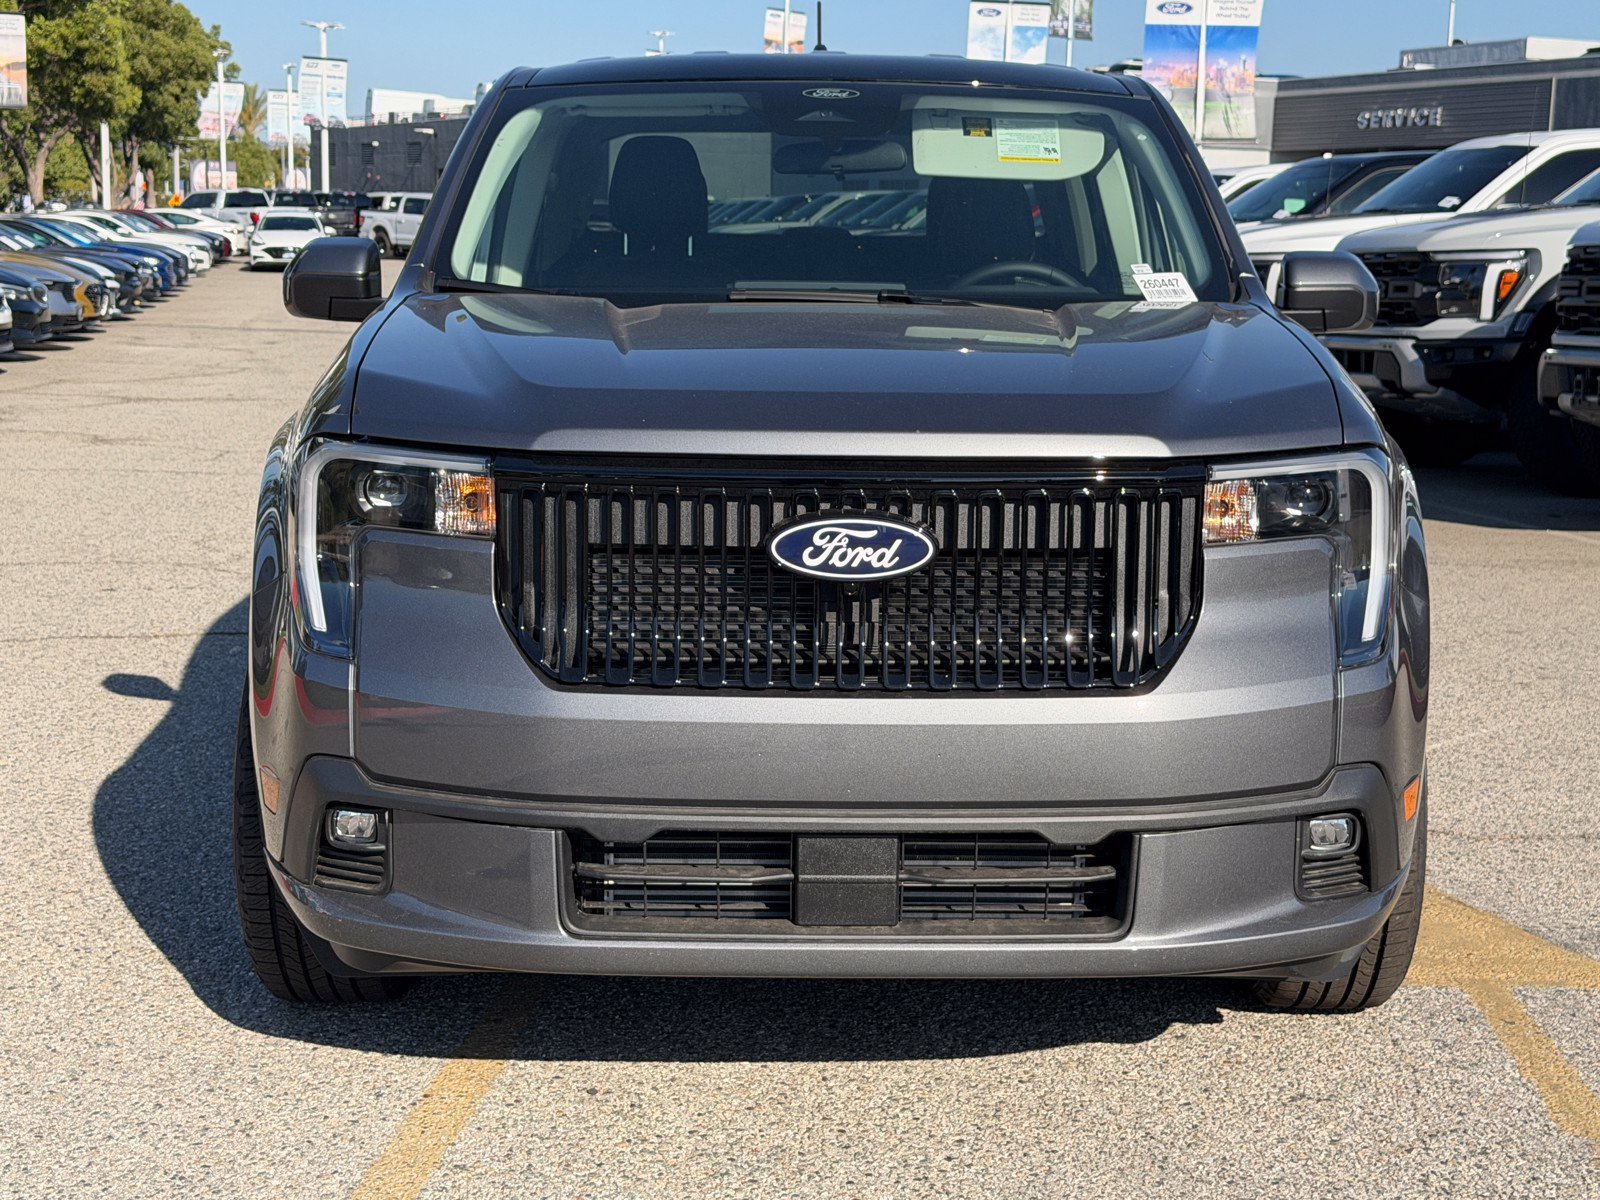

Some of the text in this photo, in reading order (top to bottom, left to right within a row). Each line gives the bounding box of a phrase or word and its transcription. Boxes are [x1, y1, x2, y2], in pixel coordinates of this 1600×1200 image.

[812, 88, 849, 98] Ford
[1357, 107, 1443, 129] SERVICE
[1140, 278, 1179, 289] 260447
[802, 526, 903, 568] Ford
